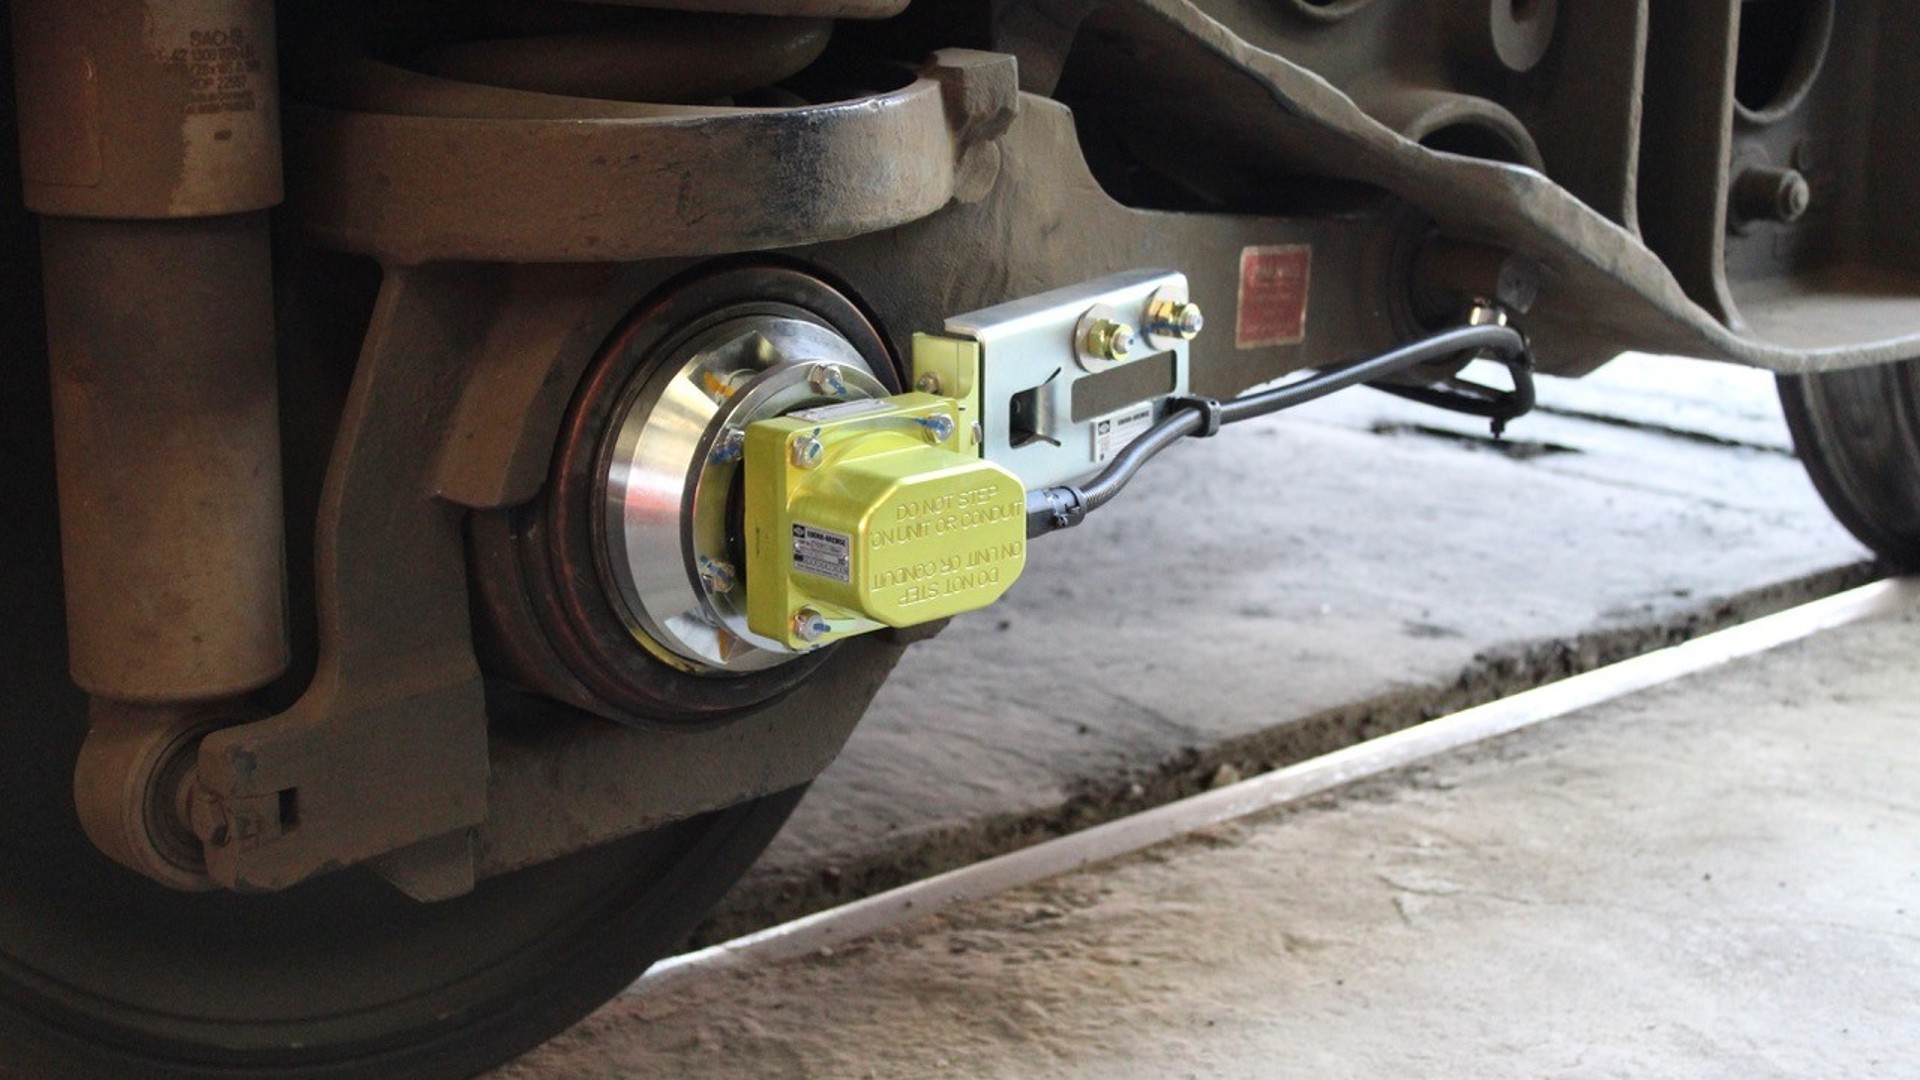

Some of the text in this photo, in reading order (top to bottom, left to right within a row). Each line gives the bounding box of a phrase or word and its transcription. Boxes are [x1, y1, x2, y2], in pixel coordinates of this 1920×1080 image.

[896, 484, 999, 523] DO NOT STEP
[870, 501, 1024, 550] ON UNIT OR CONDUIT
[871, 561, 937, 593] CONDUIT
[940, 555, 962, 576] OR
[898, 581, 941, 607] STEP
[944, 573, 975, 597] NOT
